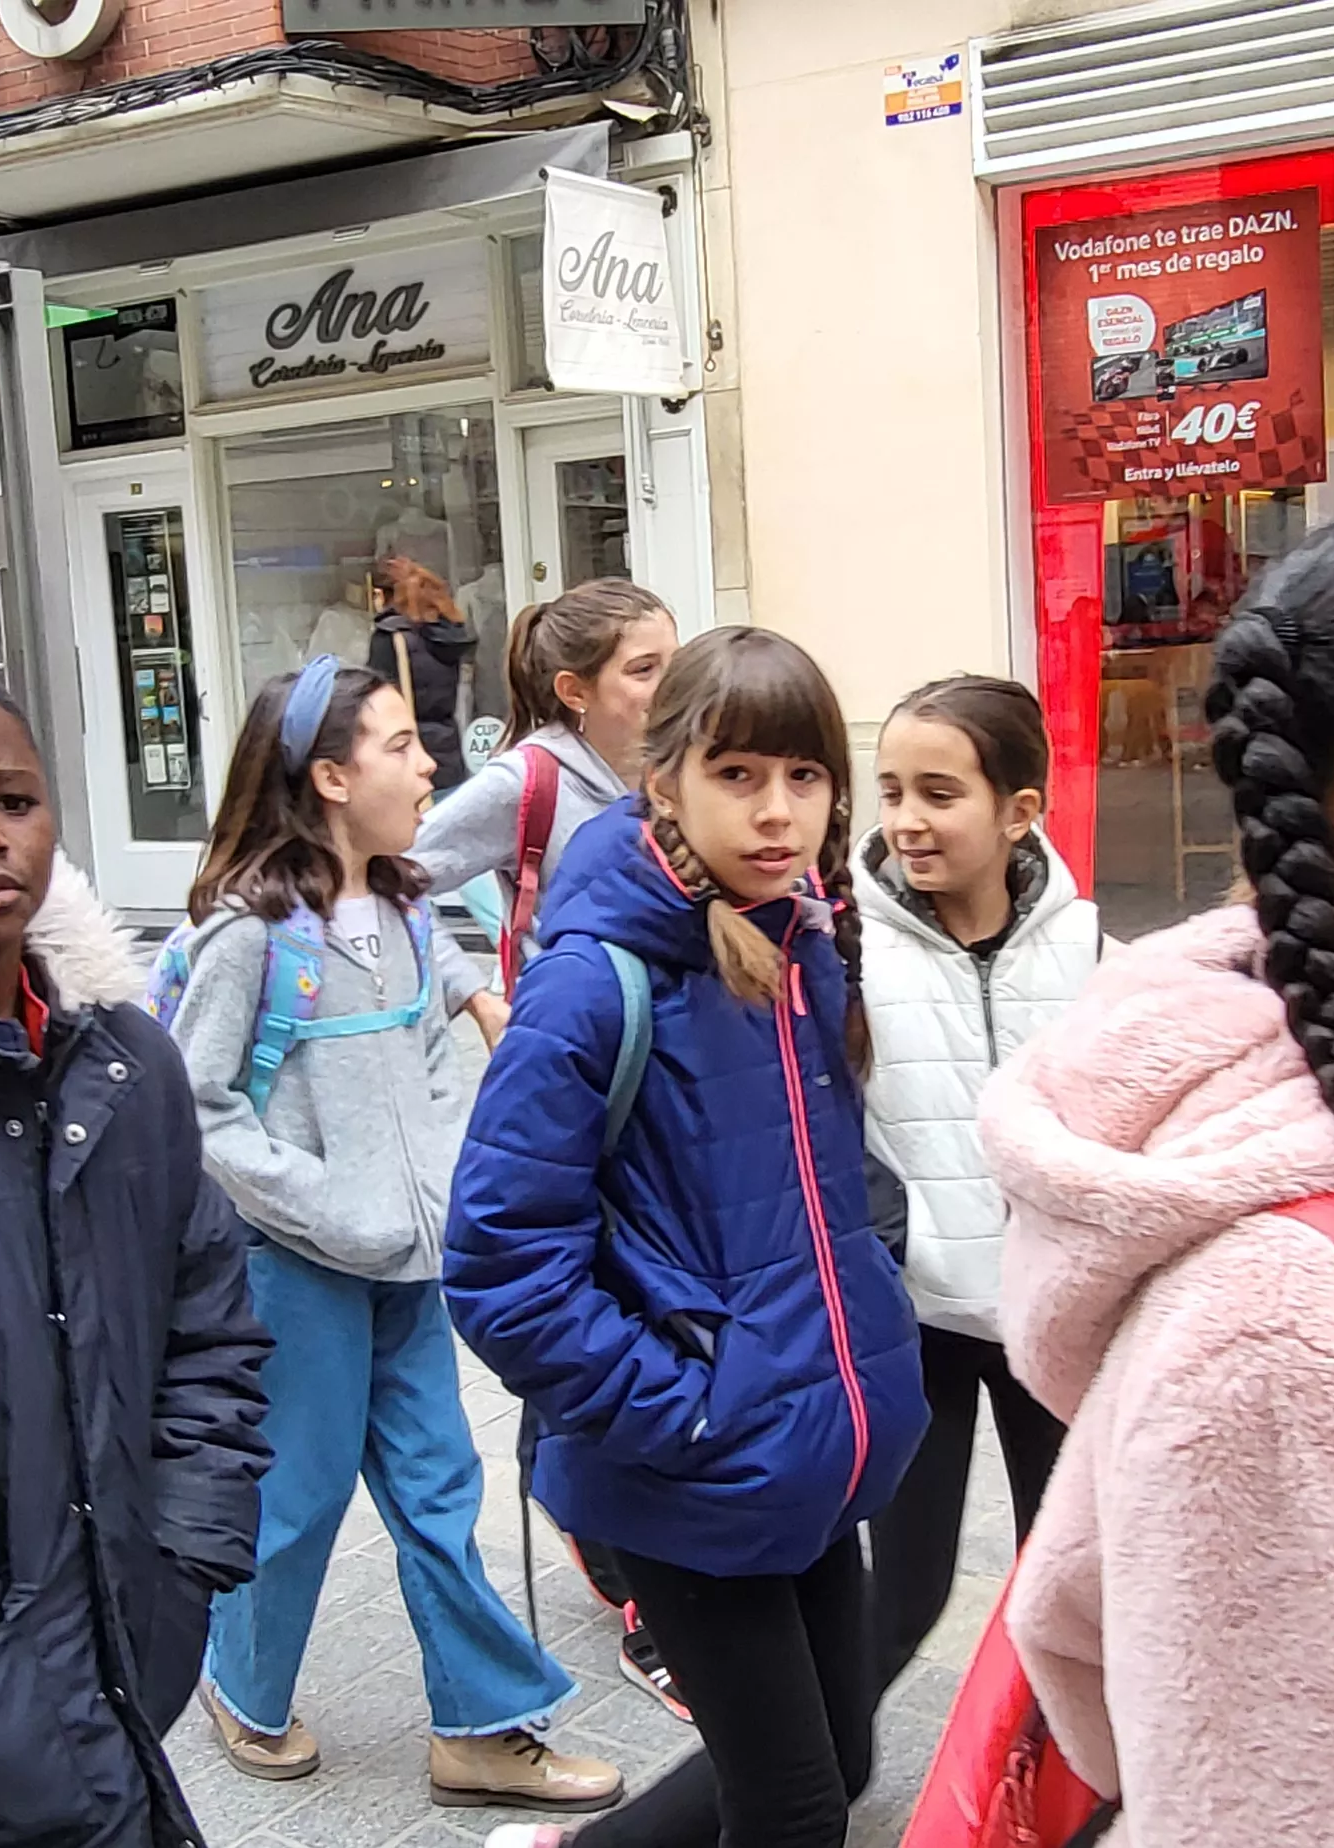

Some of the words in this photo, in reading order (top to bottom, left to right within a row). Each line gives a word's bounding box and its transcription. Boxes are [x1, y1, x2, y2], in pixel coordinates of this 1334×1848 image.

[1054, 232, 1151, 261] Vodafone
[1155, 229, 1177, 247] te
[1181, 223, 1223, 244] trae
[1229, 209, 1298, 238] DAZN.
[559, 230, 664, 304] Ana
[1116, 260, 1161, 280] mes
[1165, 253, 1192, 273] de
[1196, 244, 1264, 271] regalo
[265, 268, 430, 350] Ana
[1147, 437, 1161, 448] TV
[1171, 401, 1262, 445] 40€
[1124, 468, 1163, 482] Entra
[1164, 467, 1175, 481] y
[1175, 459, 1241, 477] llévatelo
